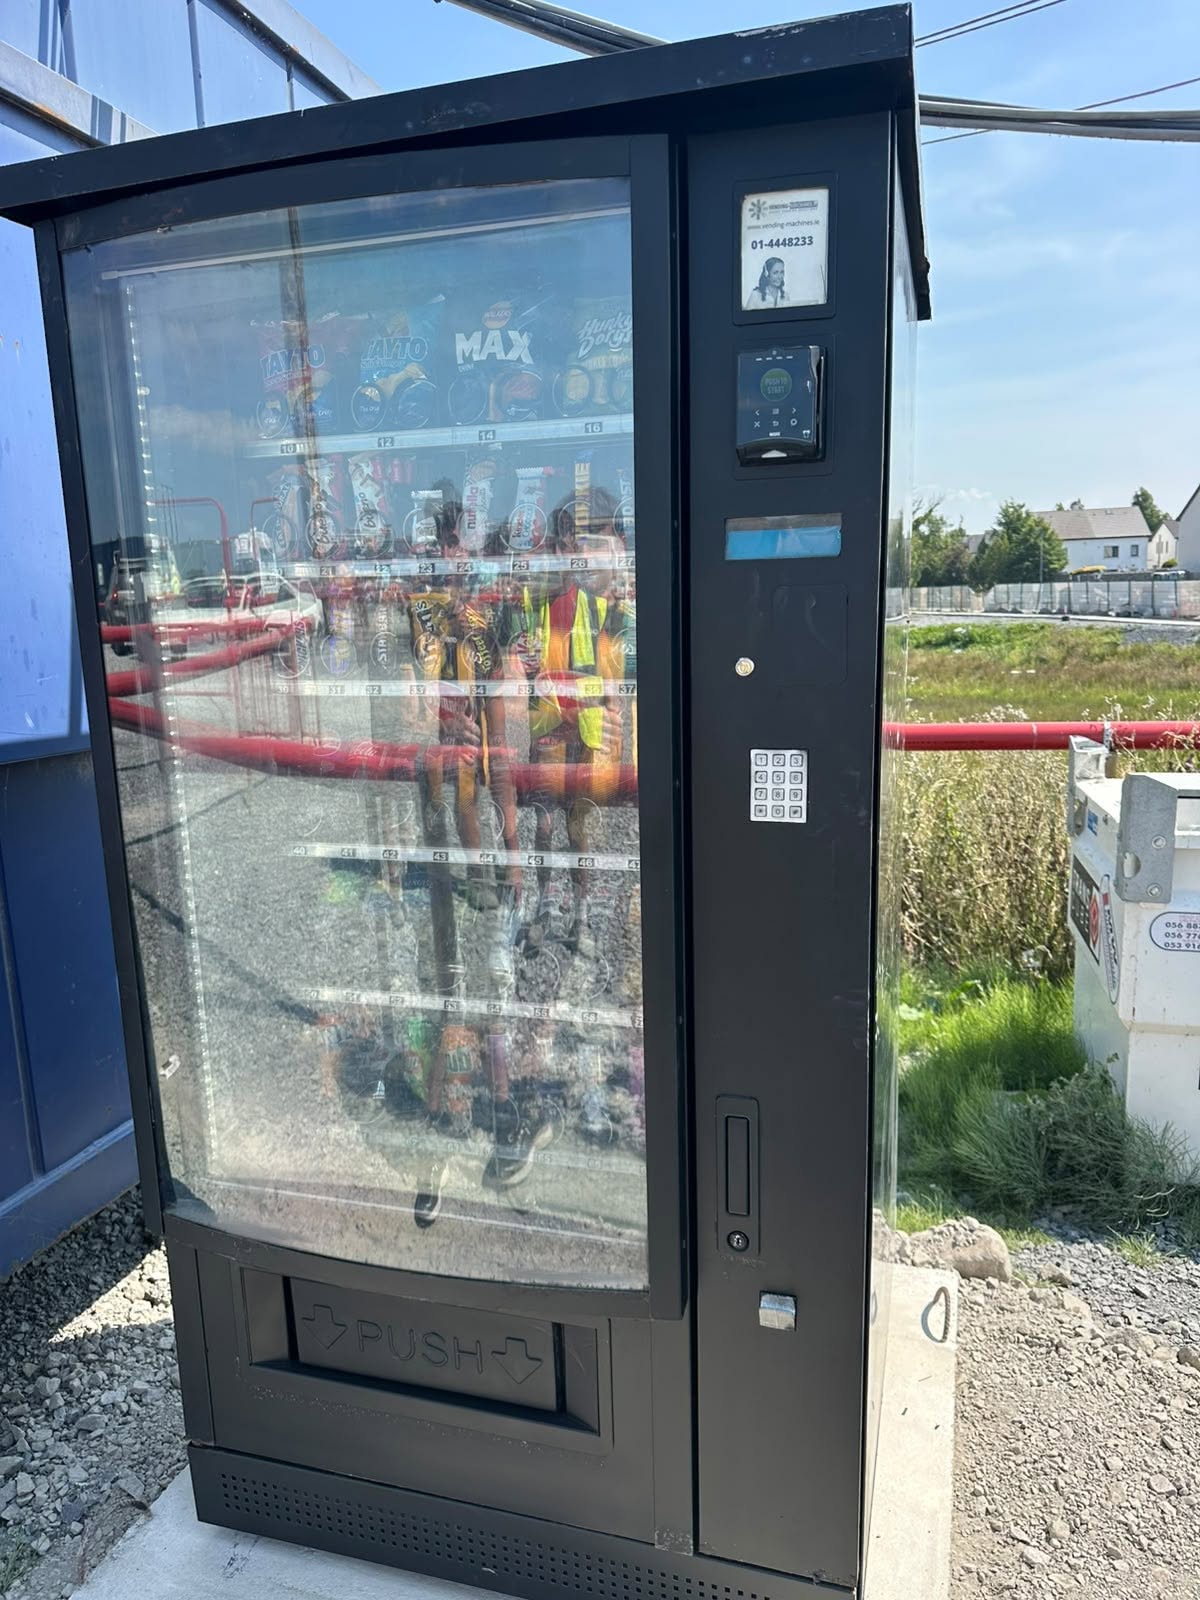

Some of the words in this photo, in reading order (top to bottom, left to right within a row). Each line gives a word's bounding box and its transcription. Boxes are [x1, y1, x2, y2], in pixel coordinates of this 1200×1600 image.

[751, 236, 814, 250] 01-4448233
[455, 329, 534, 364] MAX
[379, 438, 394, 447] 12
[480, 431, 495, 440] 14
[586, 423, 601, 432] 16
[467, 486, 479, 530] nutella
[575, 463, 591, 535] YORKIE
[357, 492, 377, 529] bueno
[314, 502, 331, 545] bueno
[321, 566, 335, 576] 21
[420, 564, 433, 573] 23
[458, 562, 472, 572] 24
[513, 561, 528, 570] 25
[571, 559, 586, 568] 26
[619, 558, 633, 567] 27
[367, 686, 380, 694] 32
[411, 686, 425, 694] 33
[471, 686, 485, 695] 34
[519, 686, 533, 695] 35
[585, 686, 600, 695] 36
[621, 686, 635, 695] 37
[383, 850, 398, 858] 42
[433, 852, 447, 860] 43
[480, 855, 494, 863] 44
[528, 856, 542, 865] 45
[578, 858, 593, 867] 46
[1164, 931, 1183, 939] 056
[1165, 921, 1183, 929] 056
[1187, 922, 1200, 930] 88
[534, 1008, 549, 1017] 55
[357, 1319, 483, 1374] PUSH
